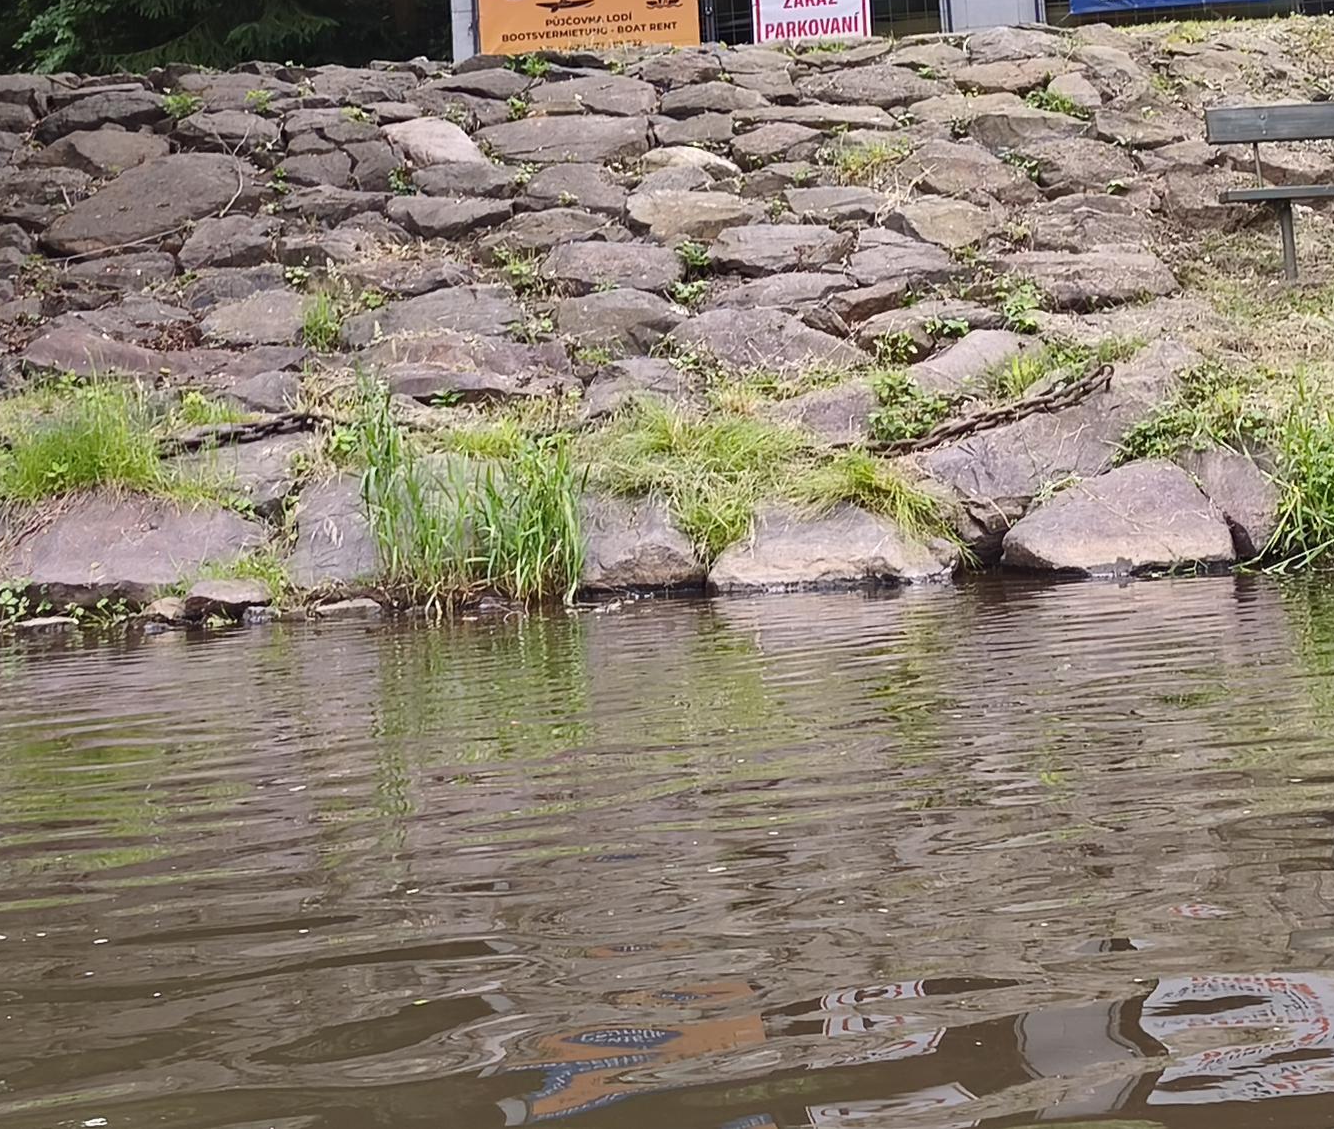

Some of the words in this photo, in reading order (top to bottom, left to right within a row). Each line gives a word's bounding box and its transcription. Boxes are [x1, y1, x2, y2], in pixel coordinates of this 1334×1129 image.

[545, 15, 604, 27] PŮJČOVNA
[607, 11, 632, 23] LODÍ
[765, 11, 860, 39] PARKOVANÍ
[617, 23, 646, 34] BOAT
[649, 21, 677, 31] RENT
